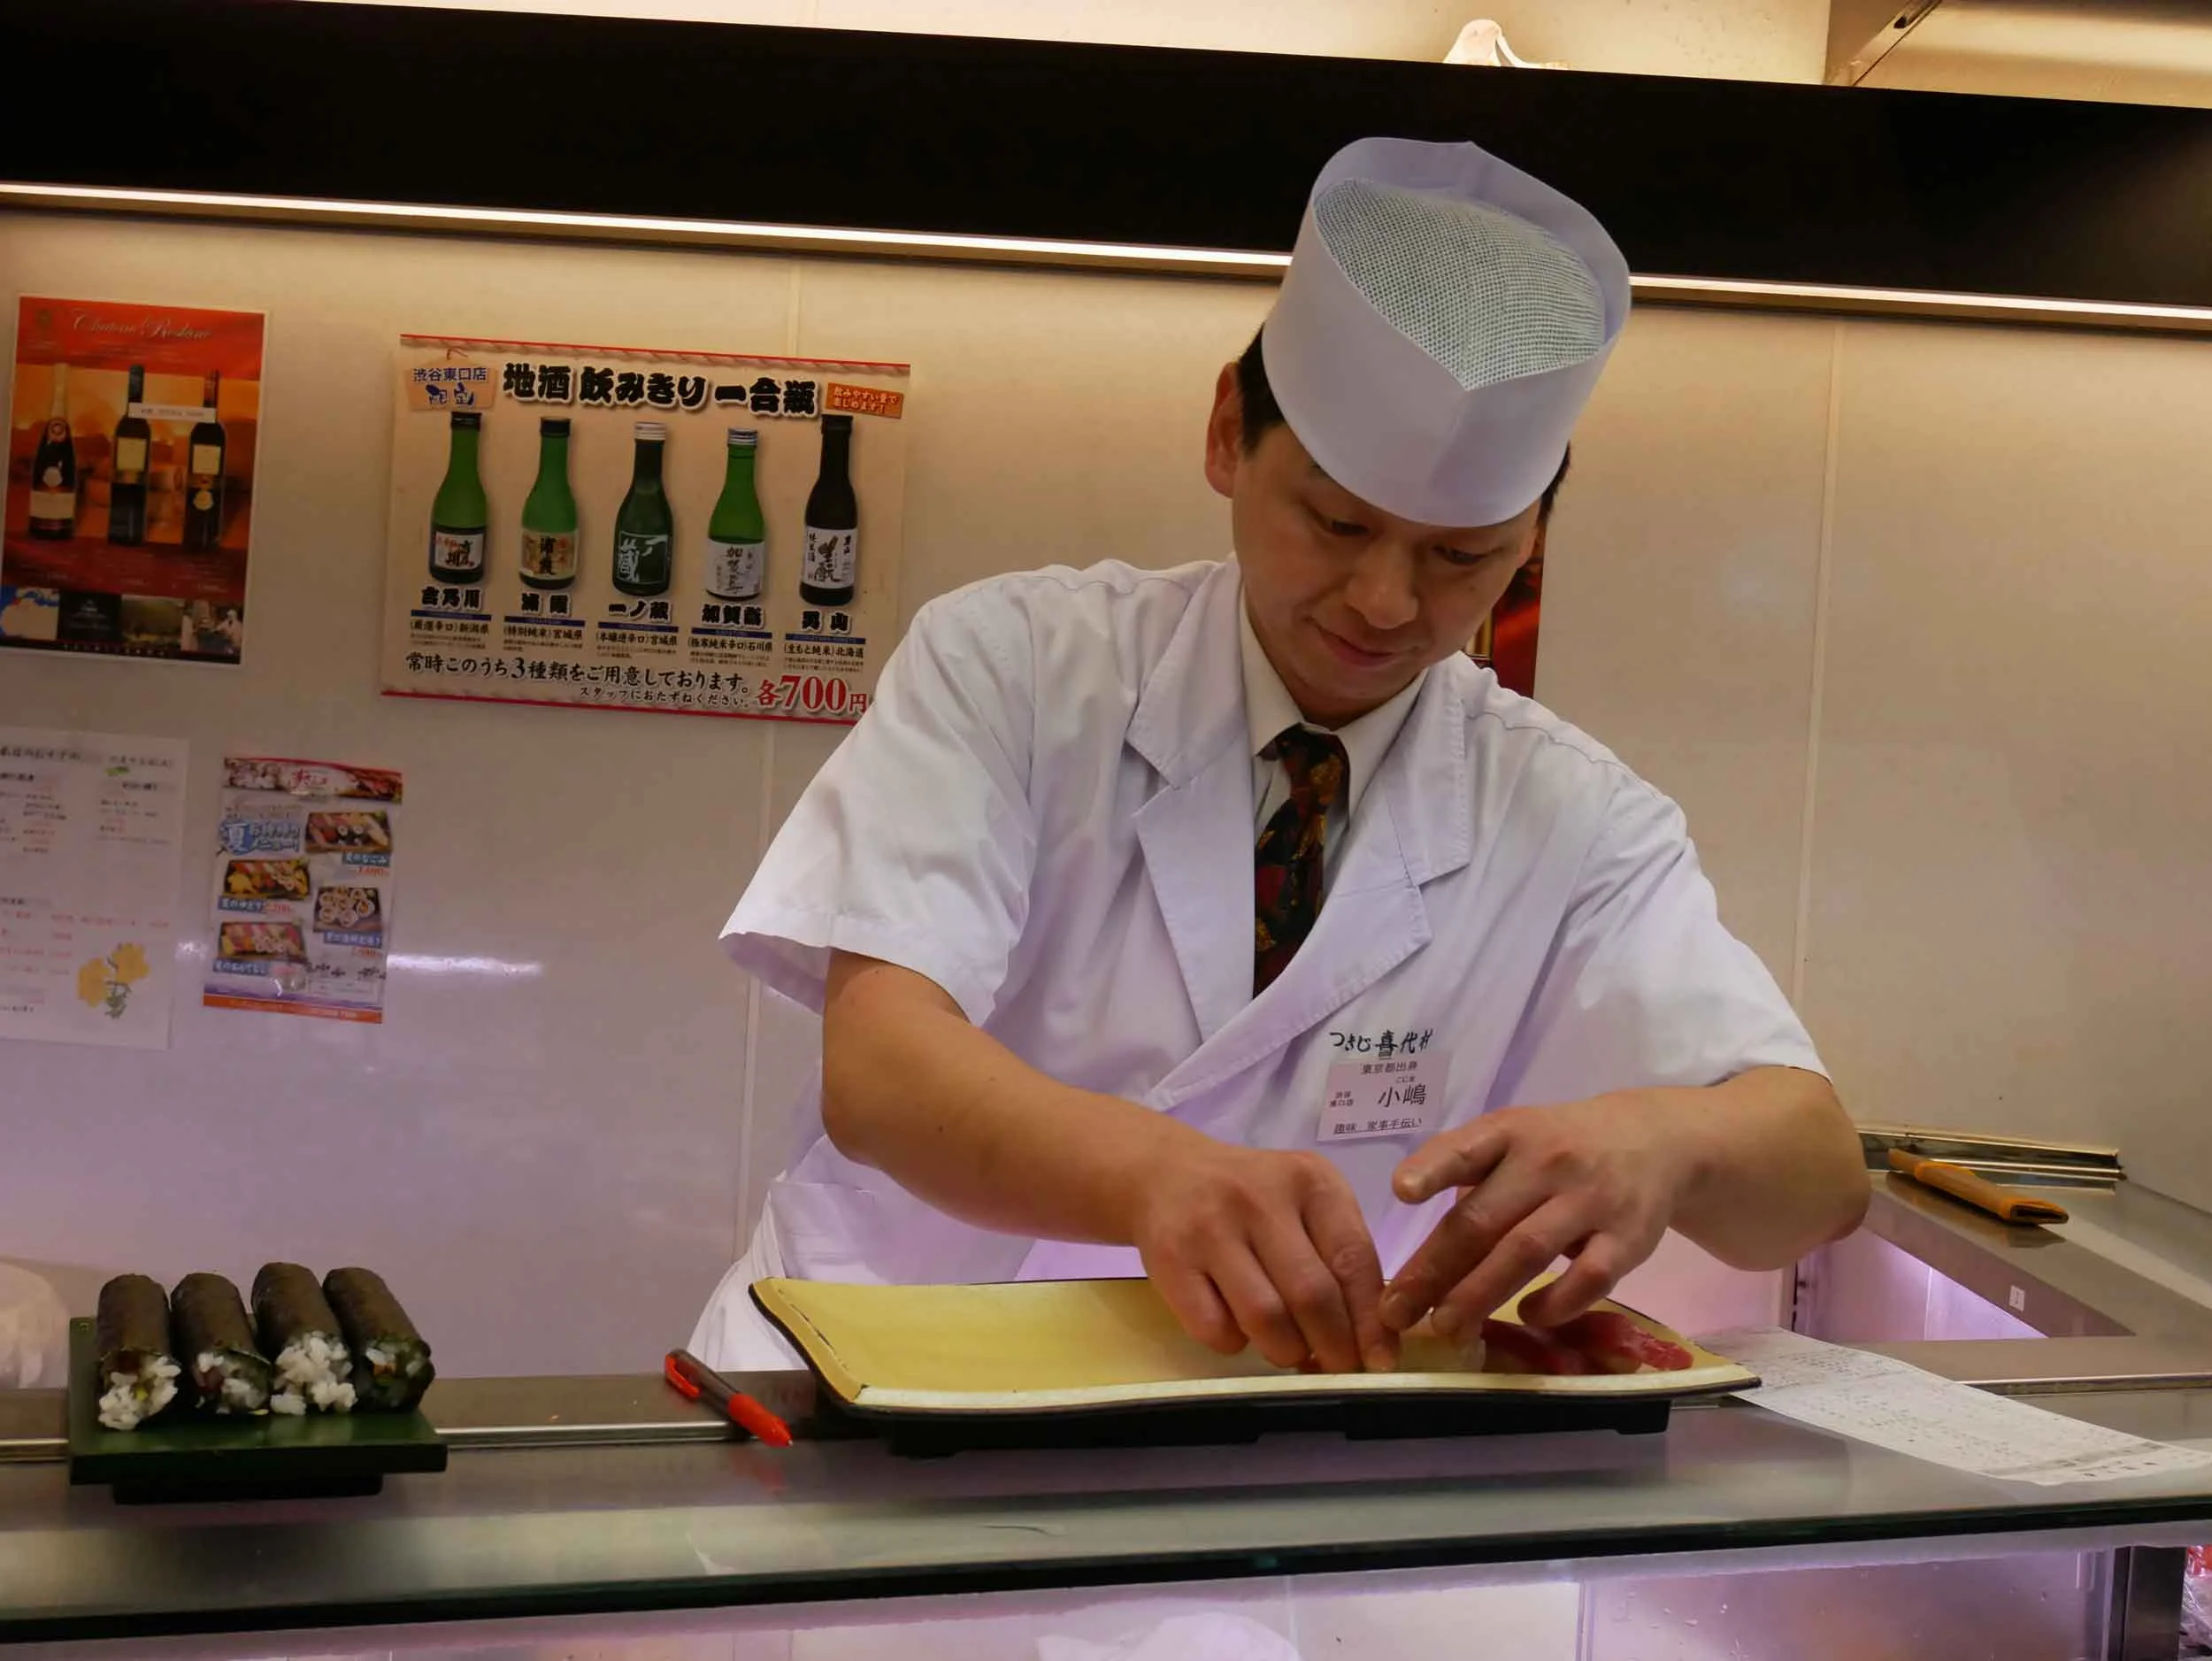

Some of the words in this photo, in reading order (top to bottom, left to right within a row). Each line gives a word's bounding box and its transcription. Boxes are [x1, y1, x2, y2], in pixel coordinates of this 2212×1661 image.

[413, 367, 487, 383] 渋谷東口店
[608, 600, 670, 619] 一ノ蔵
[406, 651, 750, 694] 常時このうち3種類をご用意しております。
[580, 686, 750, 708] スタッフにおたずねください。
[1362, 1061, 1418, 1075] 東京都出身
[1378, 1084, 1426, 1108] 小嶋
